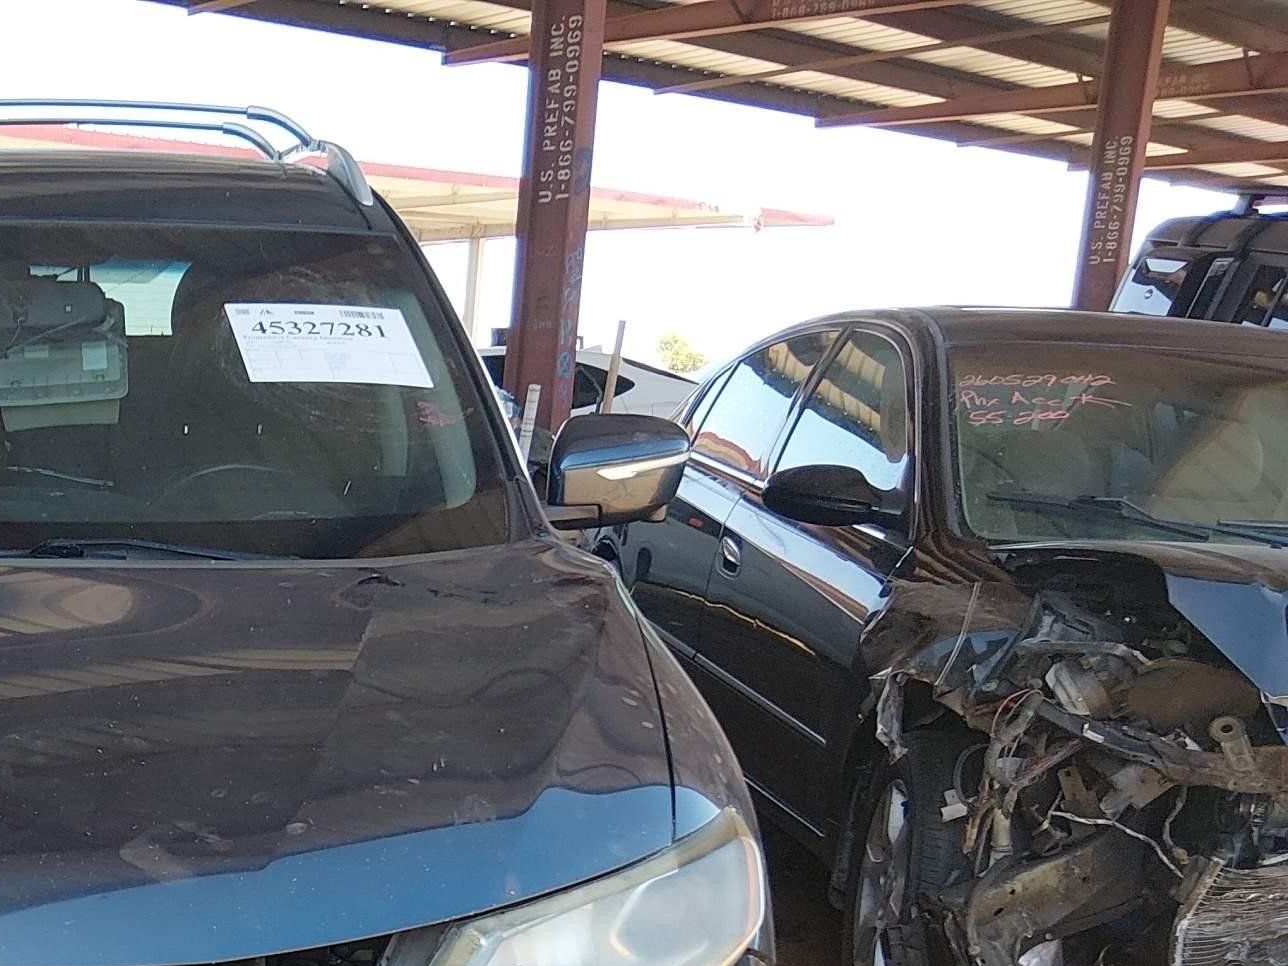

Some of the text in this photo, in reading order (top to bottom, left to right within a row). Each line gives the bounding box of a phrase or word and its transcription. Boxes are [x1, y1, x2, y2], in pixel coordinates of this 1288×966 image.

[539, 16, 566, 203] U.S. PREFAB INC.
[555, 14, 583, 200] 1-866-799-0969
[1088, 136, 1119, 265] U.S. PREFAB INC.
[1103, 135, 1133, 263] 1-866-799-0969
[251, 320, 389, 339] 45327281
